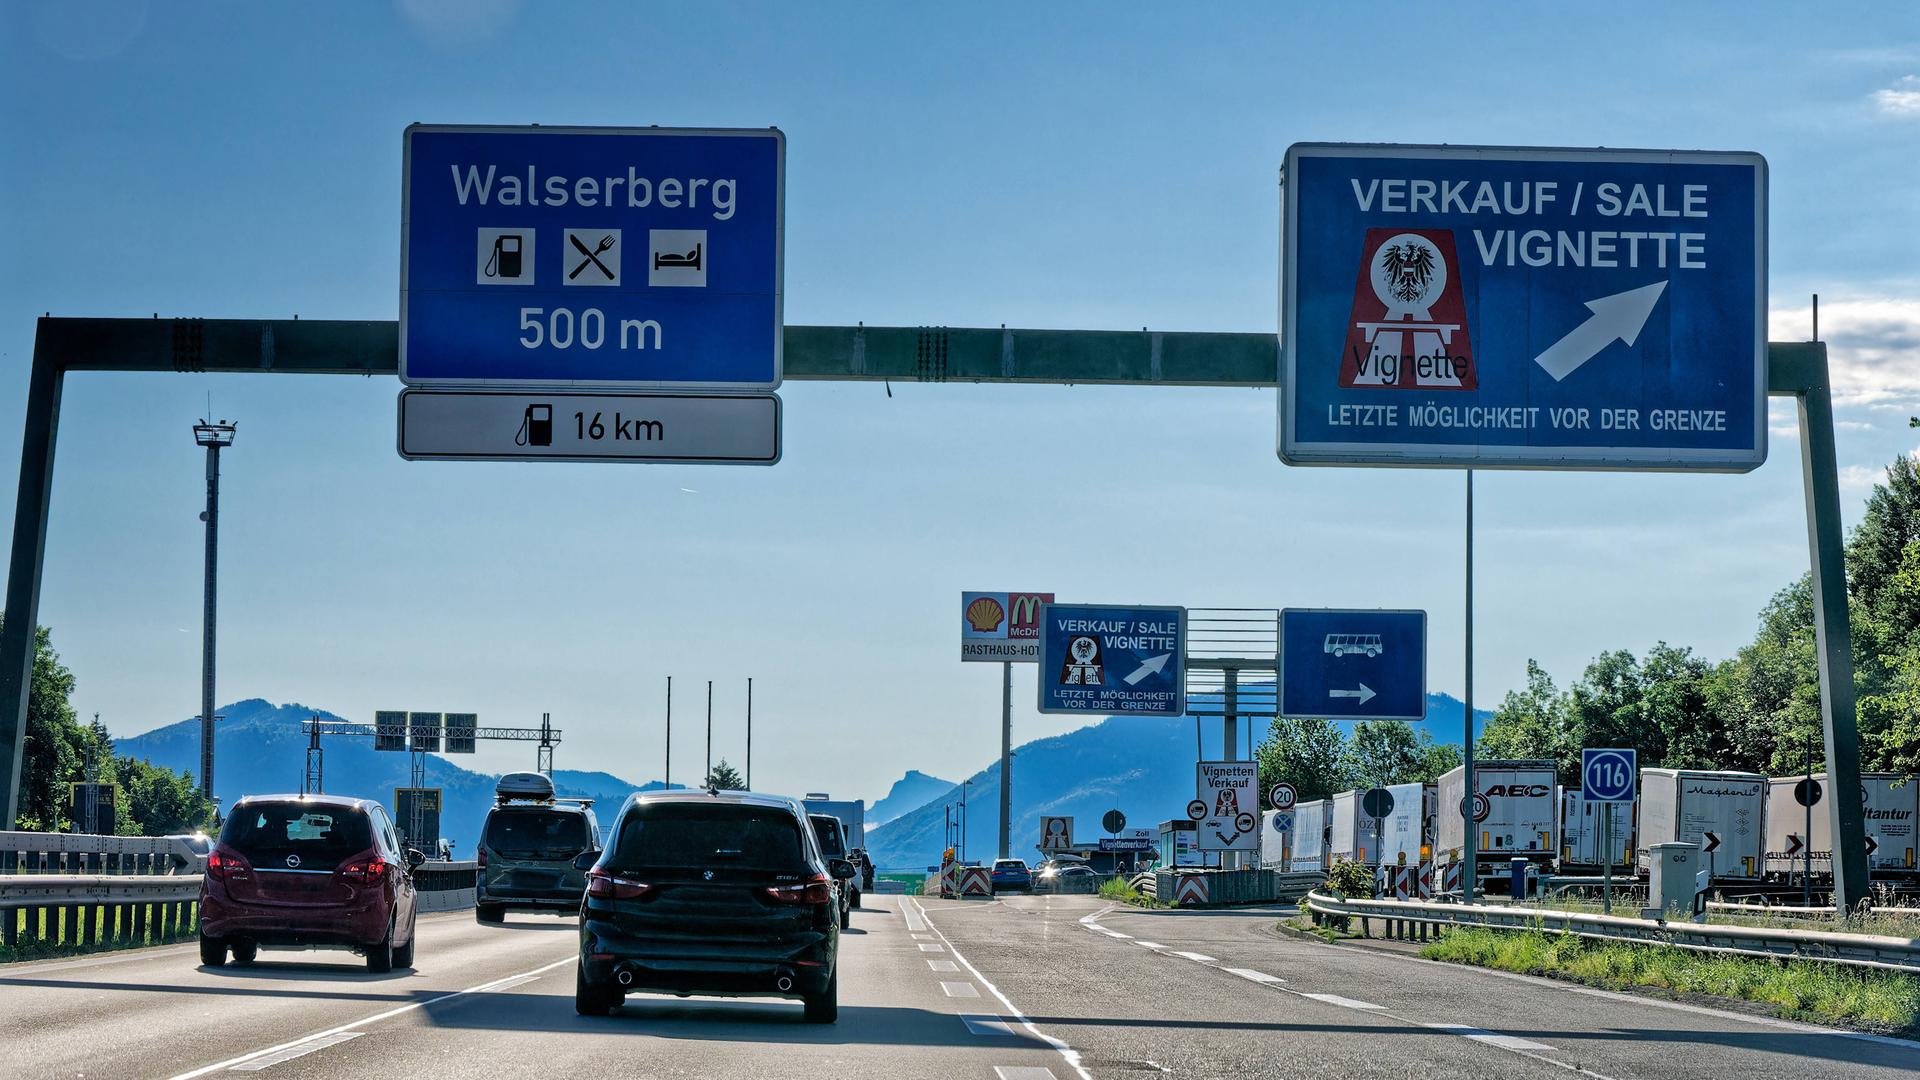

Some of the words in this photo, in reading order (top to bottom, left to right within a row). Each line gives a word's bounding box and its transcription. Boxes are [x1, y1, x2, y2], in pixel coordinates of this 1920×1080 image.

[451, 164, 737, 221] Walserberg
[1351, 179, 1558, 216] VERKAUF
[1570, 182, 1583, 216] /
[1596, 182, 1708, 218] SALE
[1473, 230, 1706, 269] VIGNETTE
[519, 307, 605, 349] 500
[620, 318, 662, 350] m
[1353, 345, 1467, 385] Vignette
[574, 411, 605, 440] 16
[615, 412, 664, 441] km
[1328, 404, 1398, 427] LETZTE
[1409, 401, 1539, 429] MÖGLICHKEIT
[1550, 407, 1590, 430] VOR
[1601, 409, 1638, 431] DER
[1650, 409, 1726, 432] GRENZE
[1058, 619, 1126, 632] VERKAUF
[1138, 622, 1177, 634] SALE
[1104, 635, 1175, 650] VIGNETTE
[1053, 689, 1094, 699] LETZTE
[1100, 689, 1176, 701] MÖGLICHKEIT
[1063, 699, 1086, 708] VOR
[1092, 700, 1115, 709] DER
[1121, 701, 1166, 710] GRENZE
[1203, 766, 1254, 778] Vignetten
[1208, 778, 1250, 788] Verkauf
[1593, 763, 1625, 788] 116
[1276, 791, 1291, 803] 20
